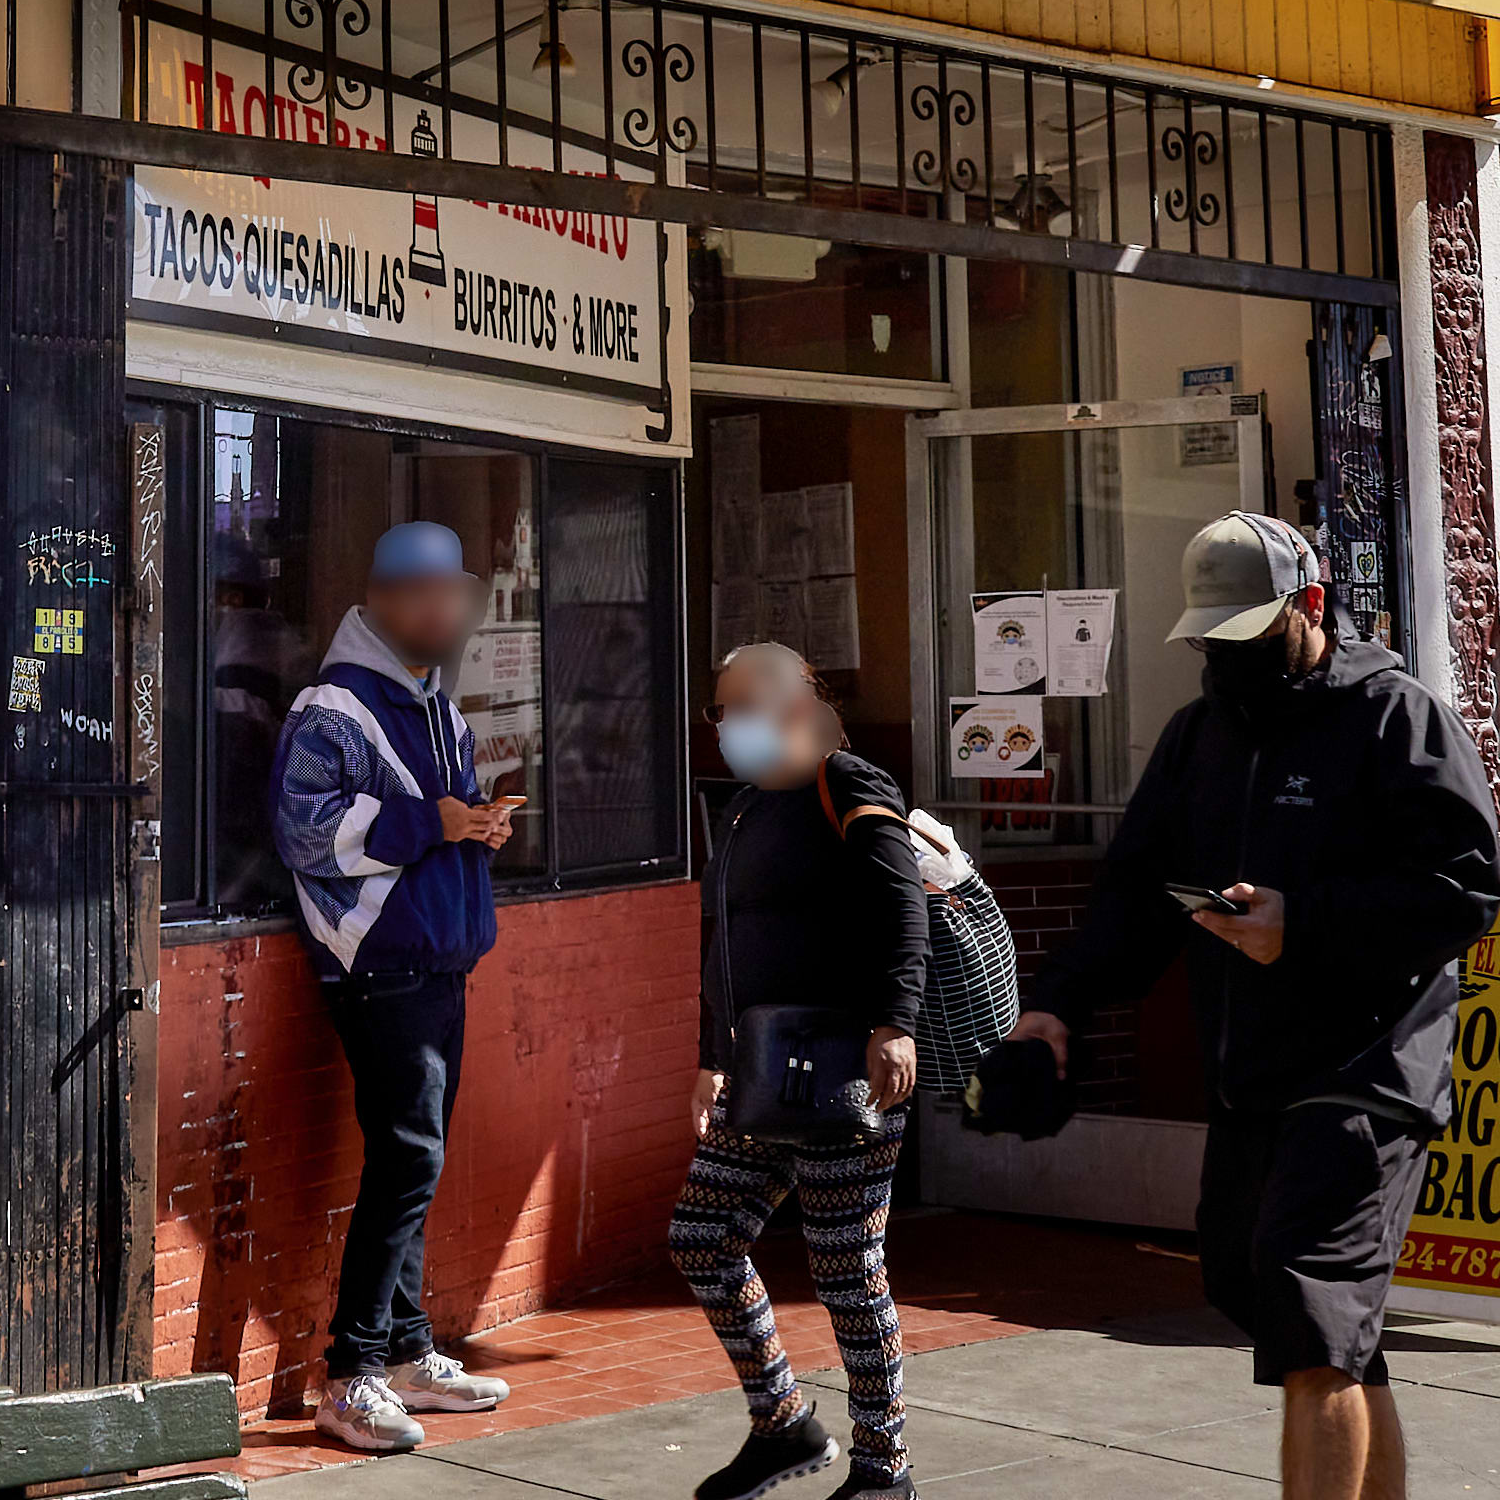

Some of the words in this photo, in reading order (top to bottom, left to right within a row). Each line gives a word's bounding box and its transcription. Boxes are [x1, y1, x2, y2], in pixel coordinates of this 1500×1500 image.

[145, 202, 235, 290] TACOS
[243, 222, 406, 325] QUESADILLAS
[454, 269, 557, 351] BURRITOS
[571, 294, 586, 355] &
[589, 297, 640, 364] MORE
[1188, 368, 1227, 384] NOTICE
[43, 611, 48, 624] 1
[68, 613, 76, 625] 9
[43, 636, 49, 649] 8
[68, 637, 76, 650] 5
[1474, 937, 1496, 975] EL
